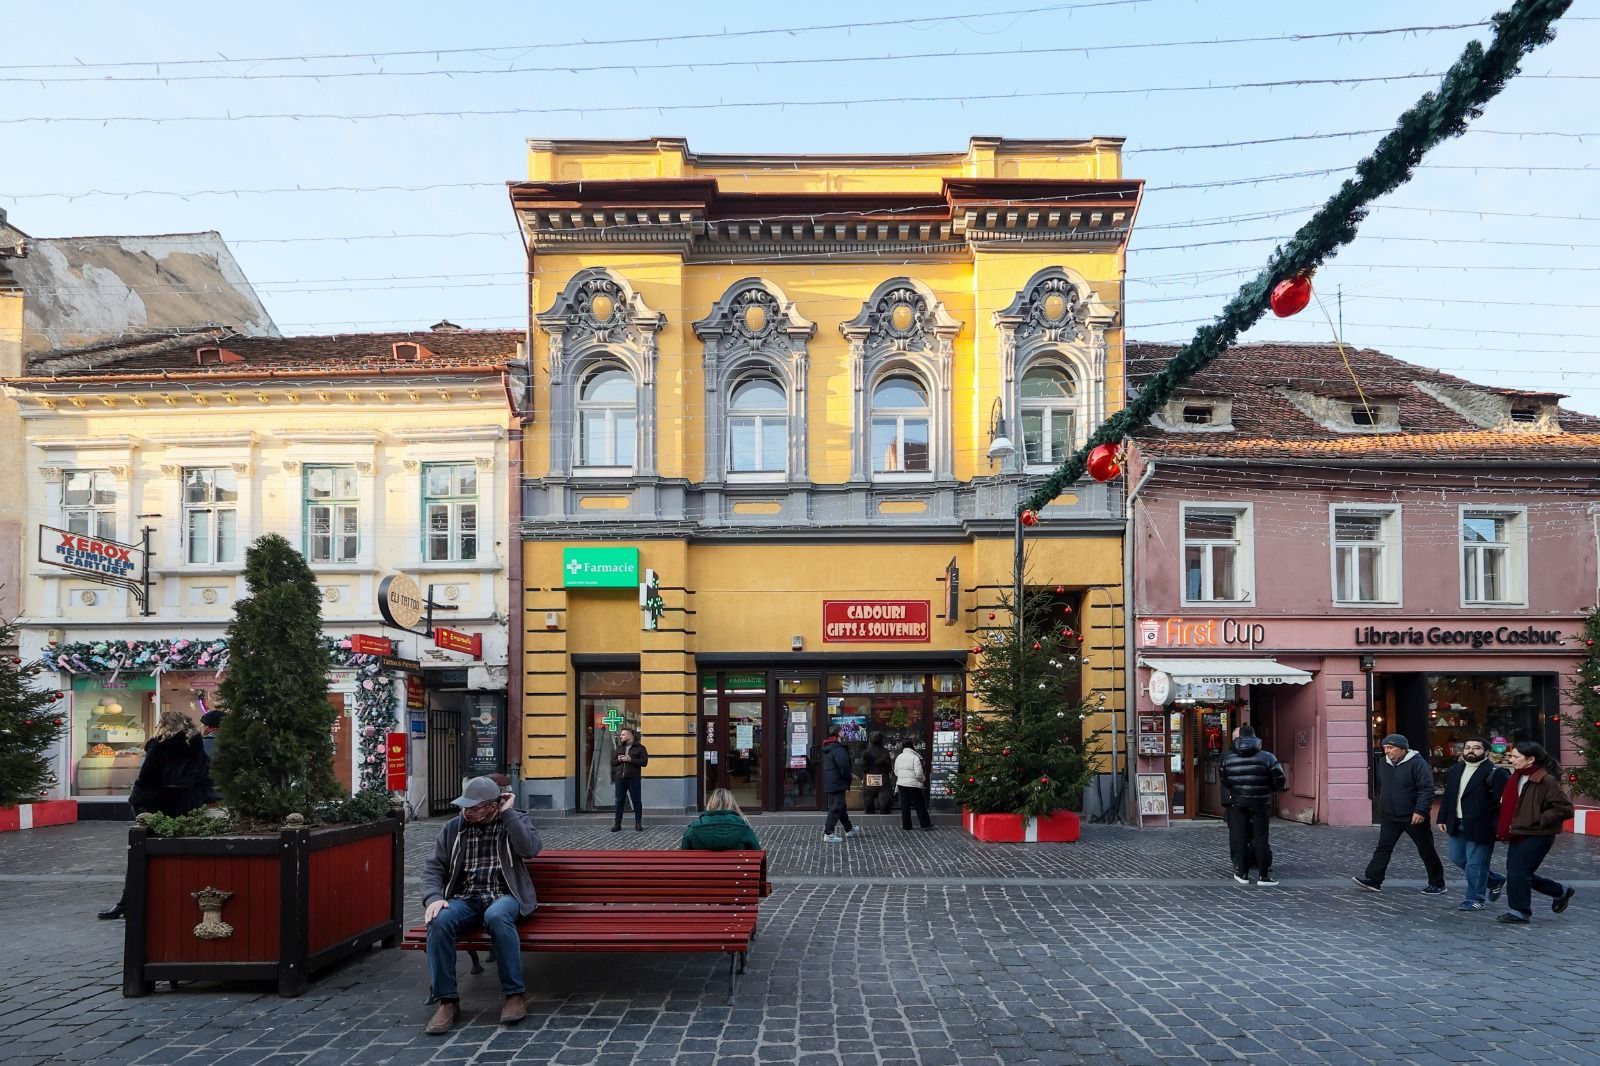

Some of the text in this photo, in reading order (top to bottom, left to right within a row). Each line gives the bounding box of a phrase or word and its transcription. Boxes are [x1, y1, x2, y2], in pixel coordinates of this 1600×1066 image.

[56, 545, 135, 570] REUMPLEM
[60, 533, 131, 562] XEROX
[64, 556, 128, 576] CARTUSE
[583, 562, 634, 572] Farmacie
[400, 595, 420, 610] TATTOO
[847, 605, 906, 619] CADOURI
[827, 622, 927, 637] GIFTS & SOUVENIRS
[1222, 617, 1265, 650] Cup
[1354, 625, 1562, 648] Libraria George Cosbuc
